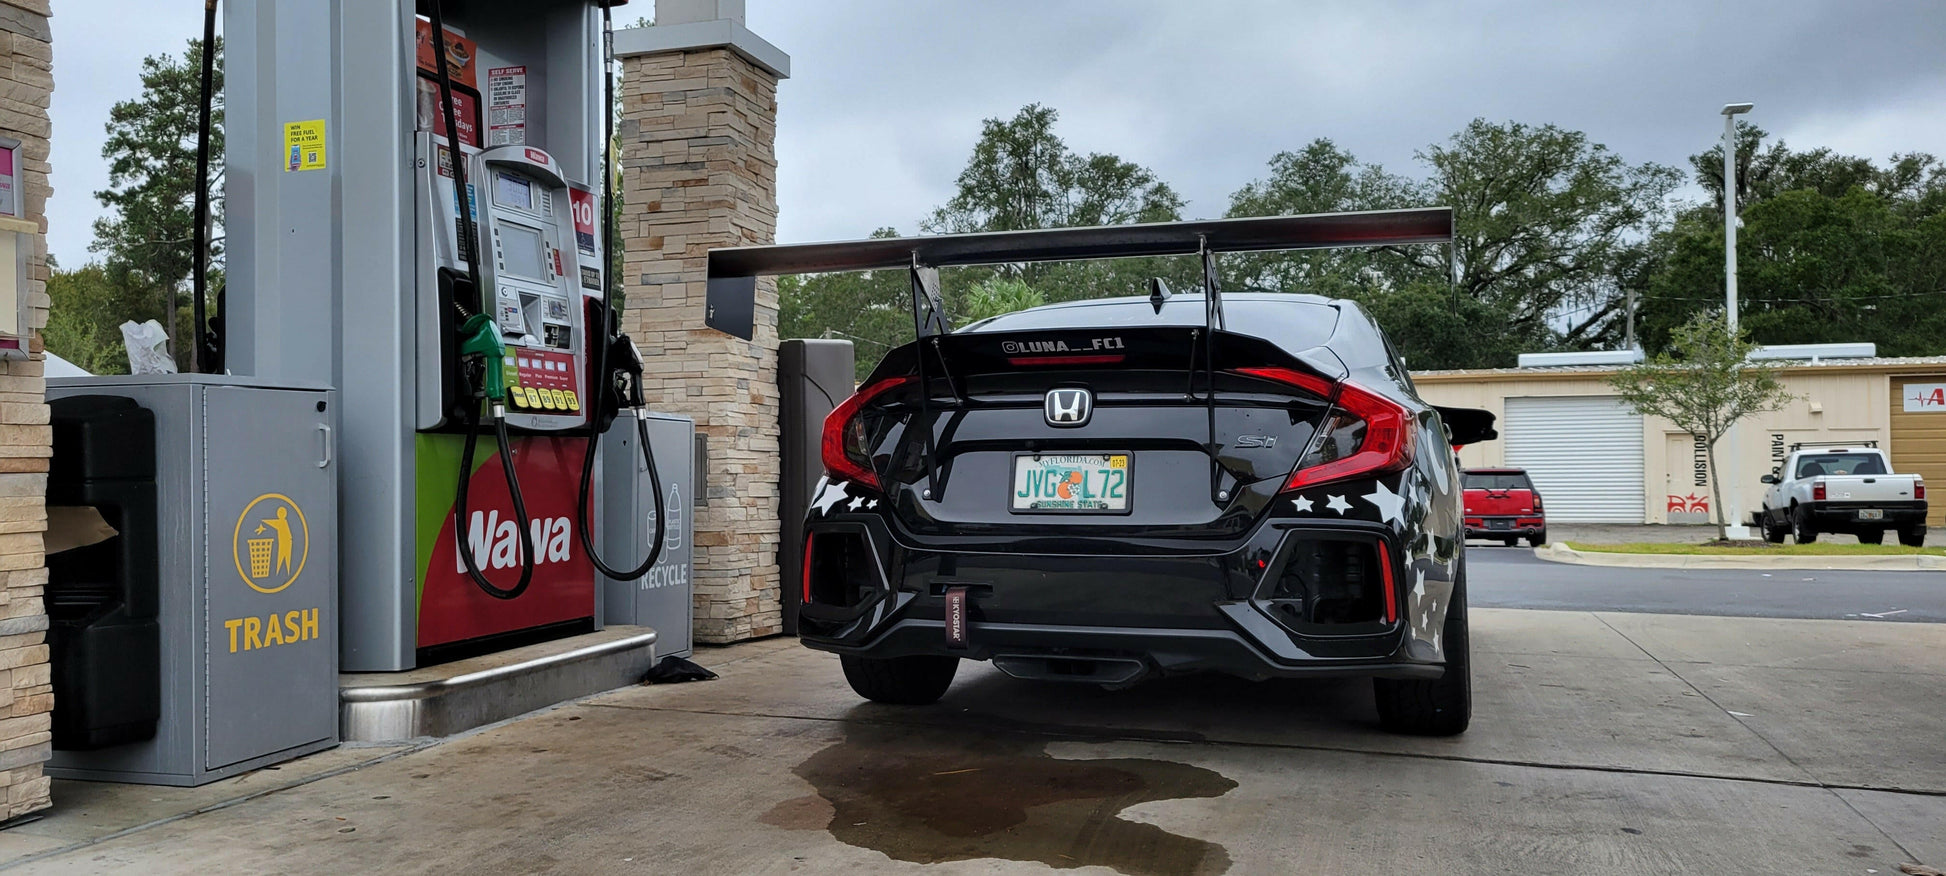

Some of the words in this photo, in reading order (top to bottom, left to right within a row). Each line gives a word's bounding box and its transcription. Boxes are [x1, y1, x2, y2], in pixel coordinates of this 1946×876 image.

[573, 200, 591, 226] 10
[542, 395, 551, 403] 89
[555, 396, 563, 404] 91
[567, 397, 576, 405] 93
[1694, 435, 1707, 486] COLLISION
[1771, 434, 1784, 462] PAINT
[1017, 469, 1057, 498] JVG
[1083, 469, 1125, 498] L72
[1036, 500, 1074, 508] SUNSHINE
[1078, 500, 1103, 508] STATE
[454, 509, 571, 574] Wawa
[641, 563, 687, 590] RECYCLE
[224, 608, 318, 653] TRASH
[952, 603, 960, 640] KYOSTAR
